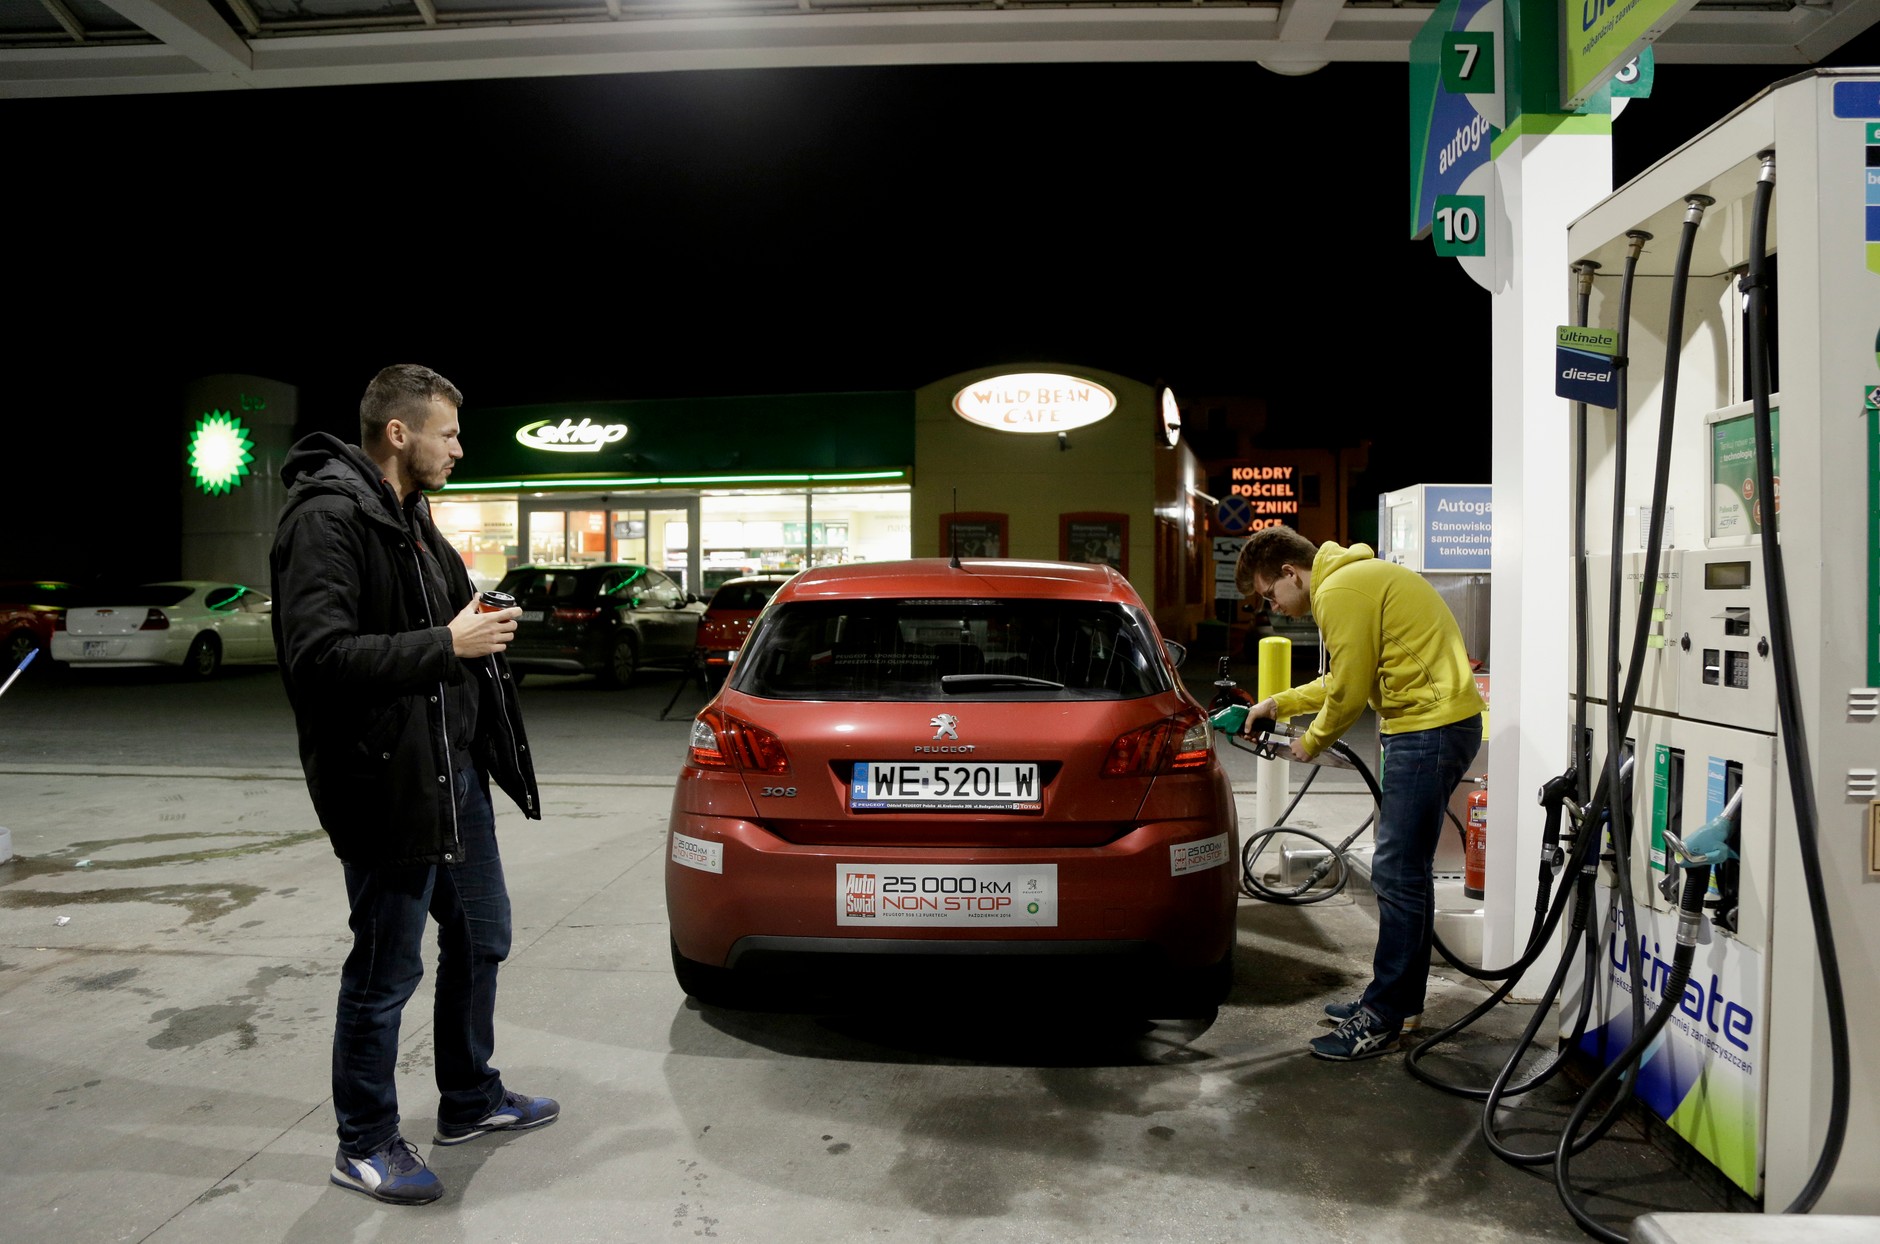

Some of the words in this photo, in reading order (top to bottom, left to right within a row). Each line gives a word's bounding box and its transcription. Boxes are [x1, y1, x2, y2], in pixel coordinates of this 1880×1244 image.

[1454, 43, 1478, 78] 7
[1436, 206, 1477, 242] 10
[1560, 332, 1612, 346] ultimate
[1562, 367, 1612, 382] diesel
[1037, 388, 1090, 404] BEAN
[1003, 408, 1061, 424] CAFE
[536, 418, 628, 452] sklep
[1232, 466, 1293, 480] KOŁDRY
[1231, 482, 1294, 497] POŚCIEL
[1431, 521, 1492, 531] Stanowisko
[914, 745, 976, 753] PEUGEOT
[874, 766, 920, 796] WE
[933, 766, 1034, 797] 520LW
[760, 786, 798, 797] 308
[855, 785, 866, 794] PL
[846, 874, 874, 894] Auto
[882, 876, 917, 894] 25
[921, 876, 977, 894] 000
[980, 881, 1011, 894] KM
[882, 896, 938, 911] NON
[944, 896, 1011, 911] STOP
[1610, 932, 1753, 1052] utimate
